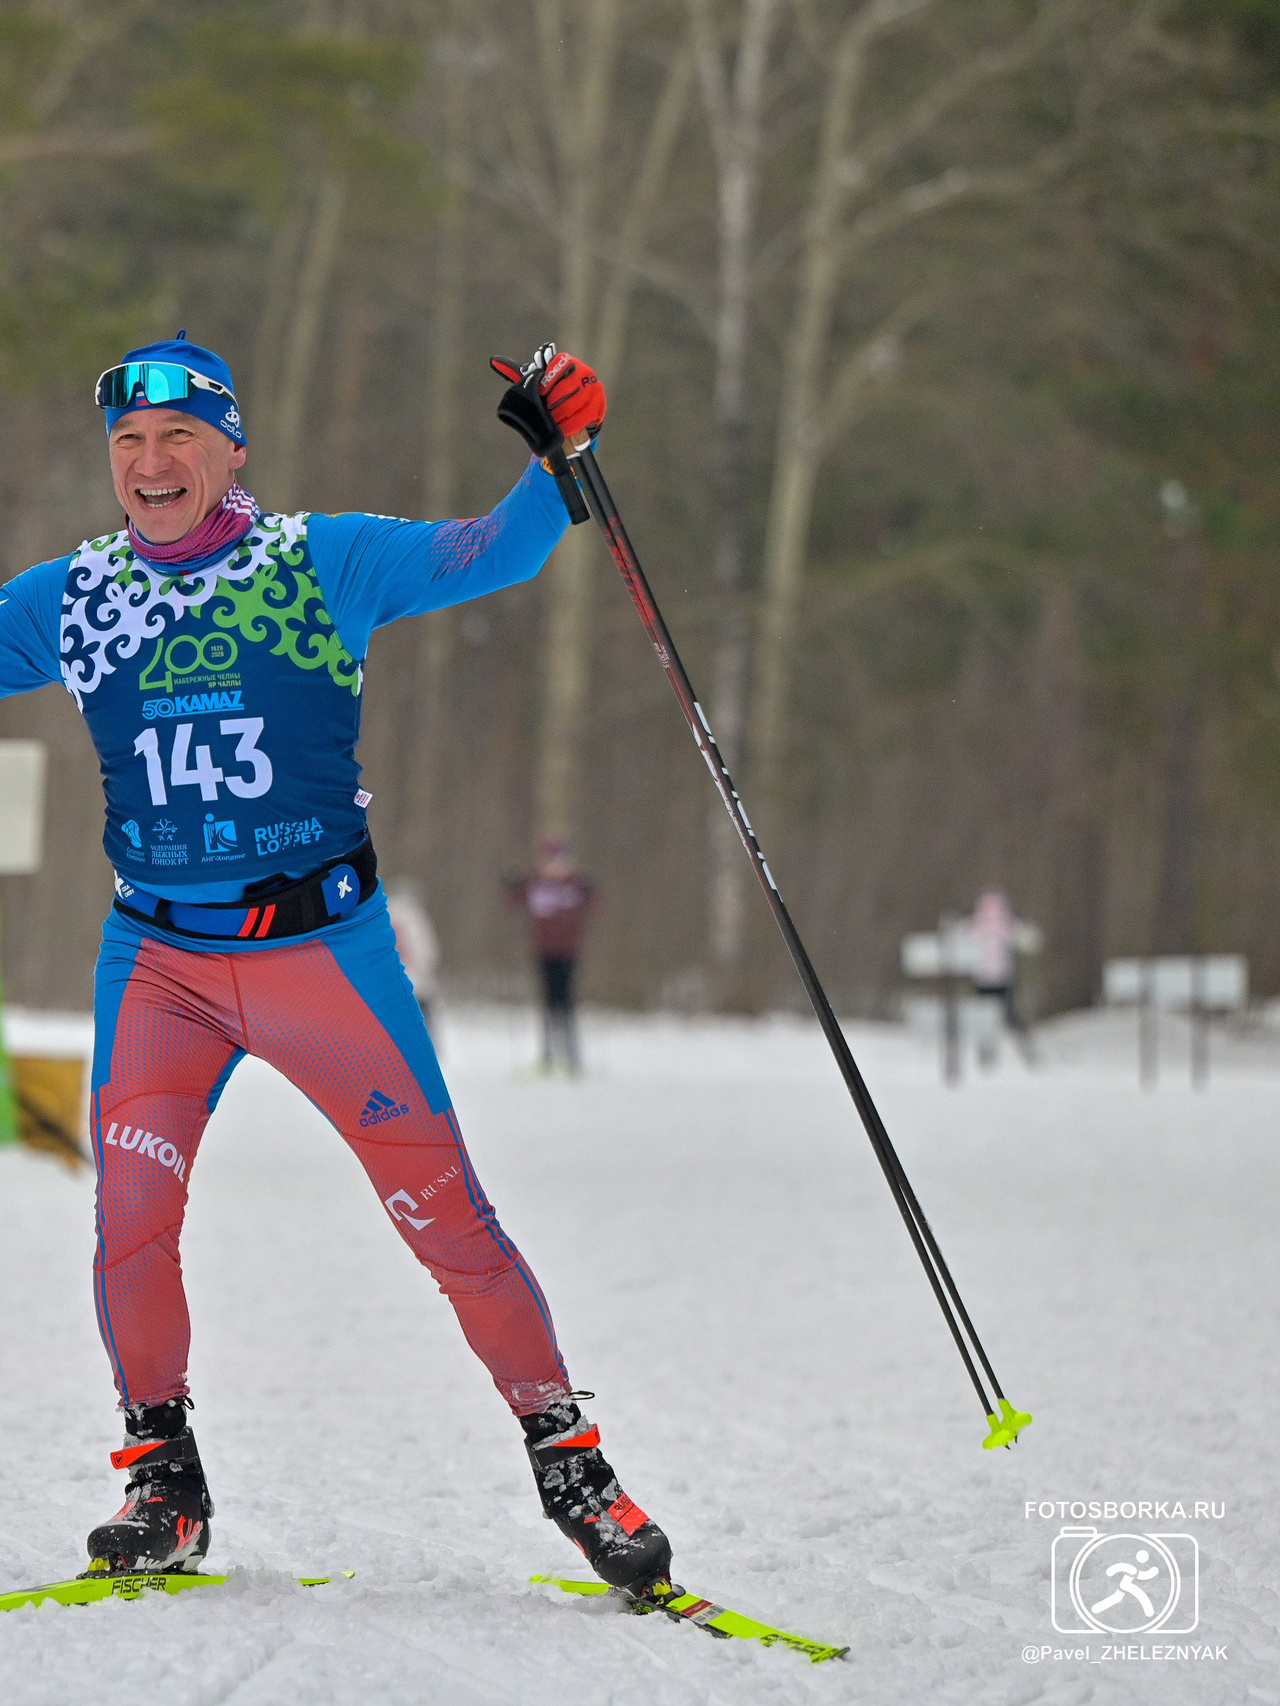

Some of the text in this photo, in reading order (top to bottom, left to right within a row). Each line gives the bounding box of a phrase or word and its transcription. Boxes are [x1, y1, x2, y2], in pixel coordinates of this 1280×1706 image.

[540, 353, 571, 387] Roeck
[220, 419, 242, 439] odlo
[139, 631, 239, 693] 400
[173, 672, 241, 685] НАБЕРЕЖНЫЕ ЧЕЛНЫ
[208, 680, 242, 689] ЯР ЧАЛЛЫ
[133, 716, 273, 806] 143
[254, 817, 322, 842] RUSSIA
[256, 829, 324, 856] LOPPET
[152, 858, 189, 866] ГОНОК РТ
[201, 854, 246, 863] АНГ-Холдинг
[359, 1104, 410, 1127] adidas
[105, 1122, 187, 1183] LUKOIL
[420, 1165, 461, 1201] RUSAL
[111, 1577, 167, 1595] FISCHER
